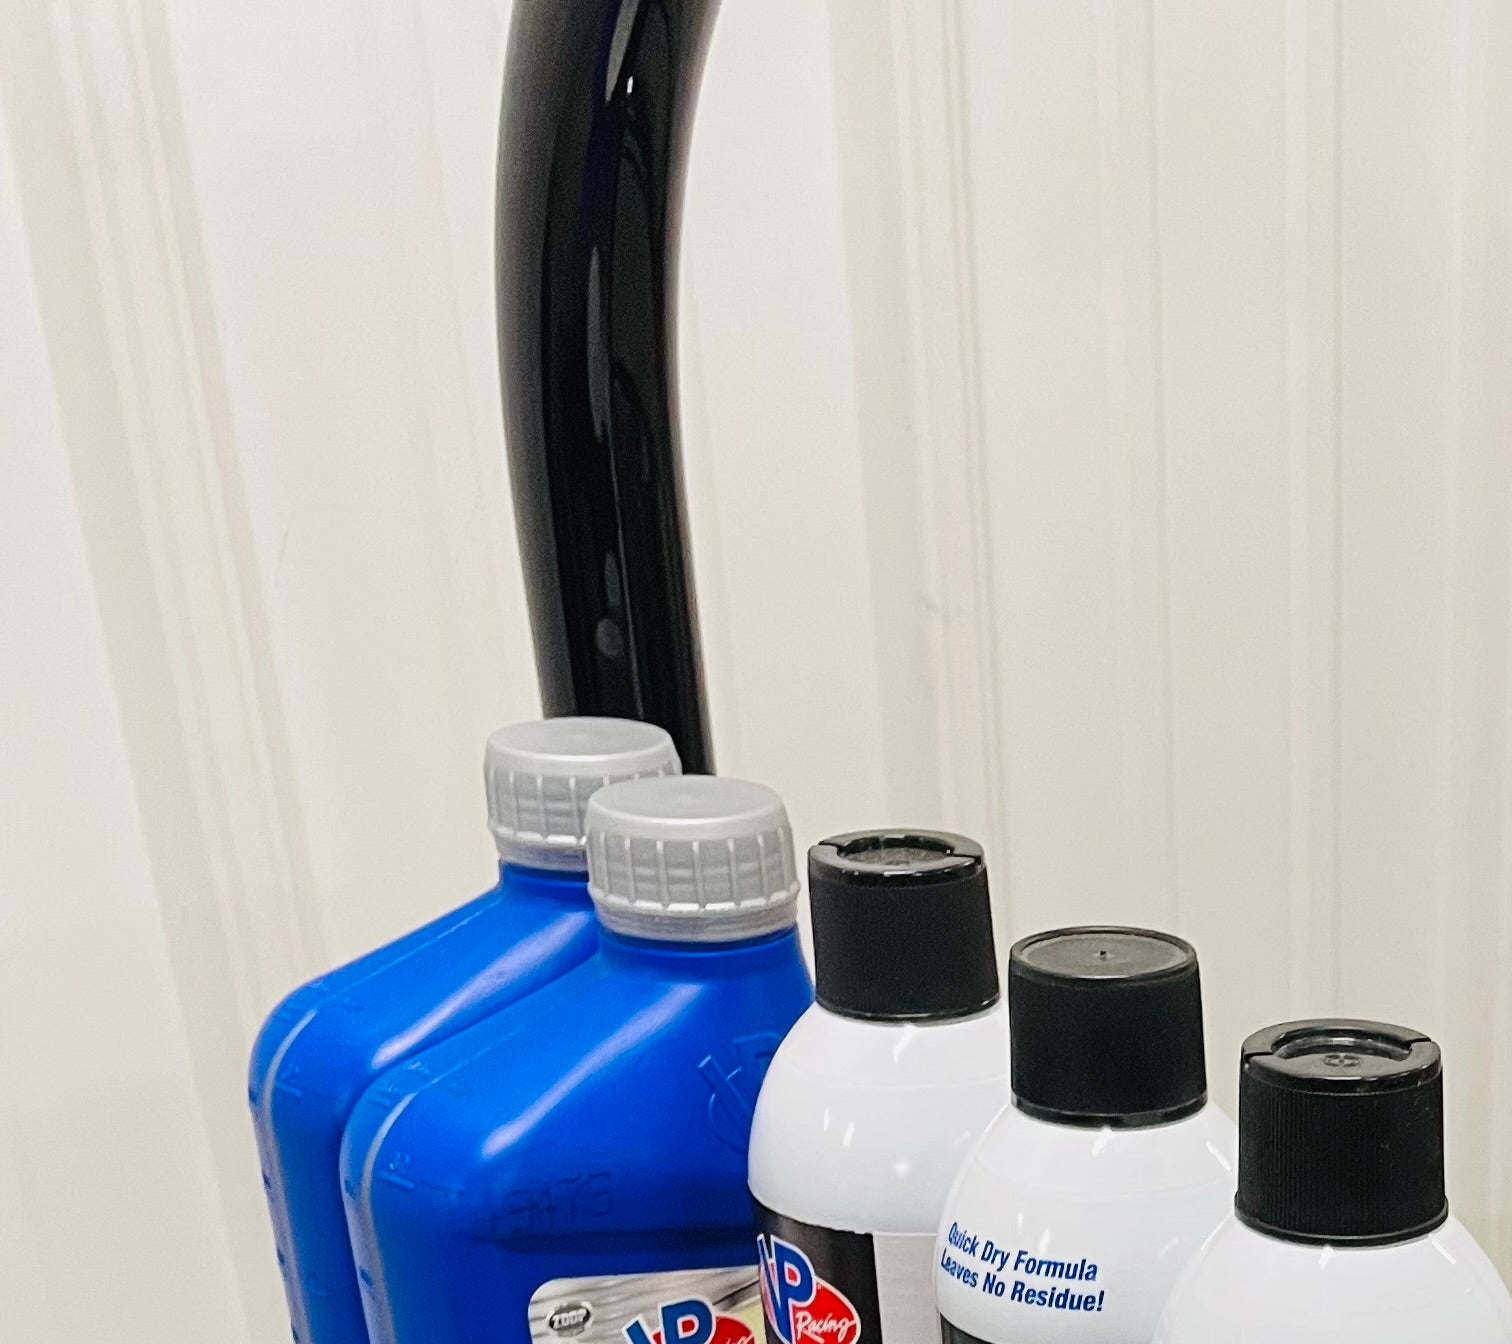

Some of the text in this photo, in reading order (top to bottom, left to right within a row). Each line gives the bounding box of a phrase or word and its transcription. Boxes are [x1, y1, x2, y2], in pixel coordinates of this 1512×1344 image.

[940, 1248, 1105, 1312] Leaves No Residue!
[948, 1222, 1098, 1281] Quick Dry Formula
[796, 1312, 857, 1344] Racing
